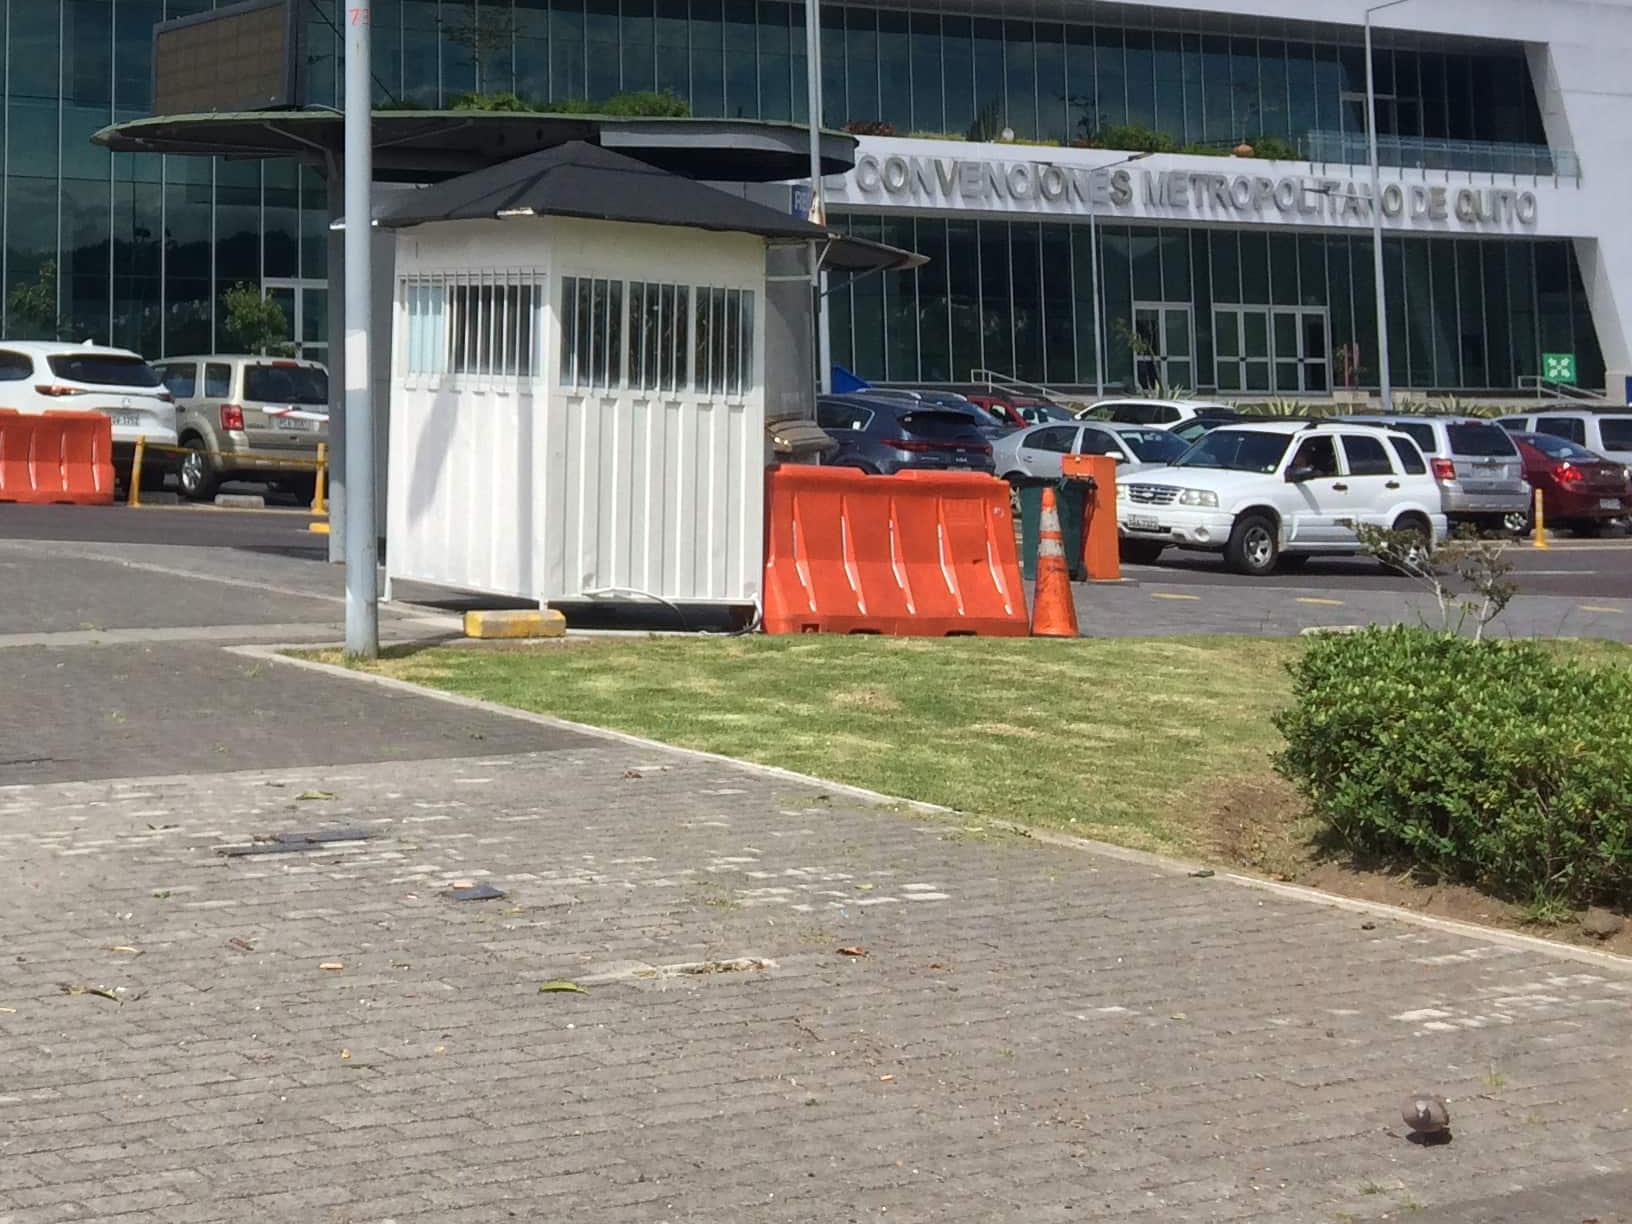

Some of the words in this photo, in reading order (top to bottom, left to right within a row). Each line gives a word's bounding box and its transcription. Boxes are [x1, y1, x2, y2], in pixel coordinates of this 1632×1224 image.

[856, 154, 1133, 207] CONVENCIONES
[1410, 185, 1448, 220] DE
[1454, 188, 1537, 224] QUITO
